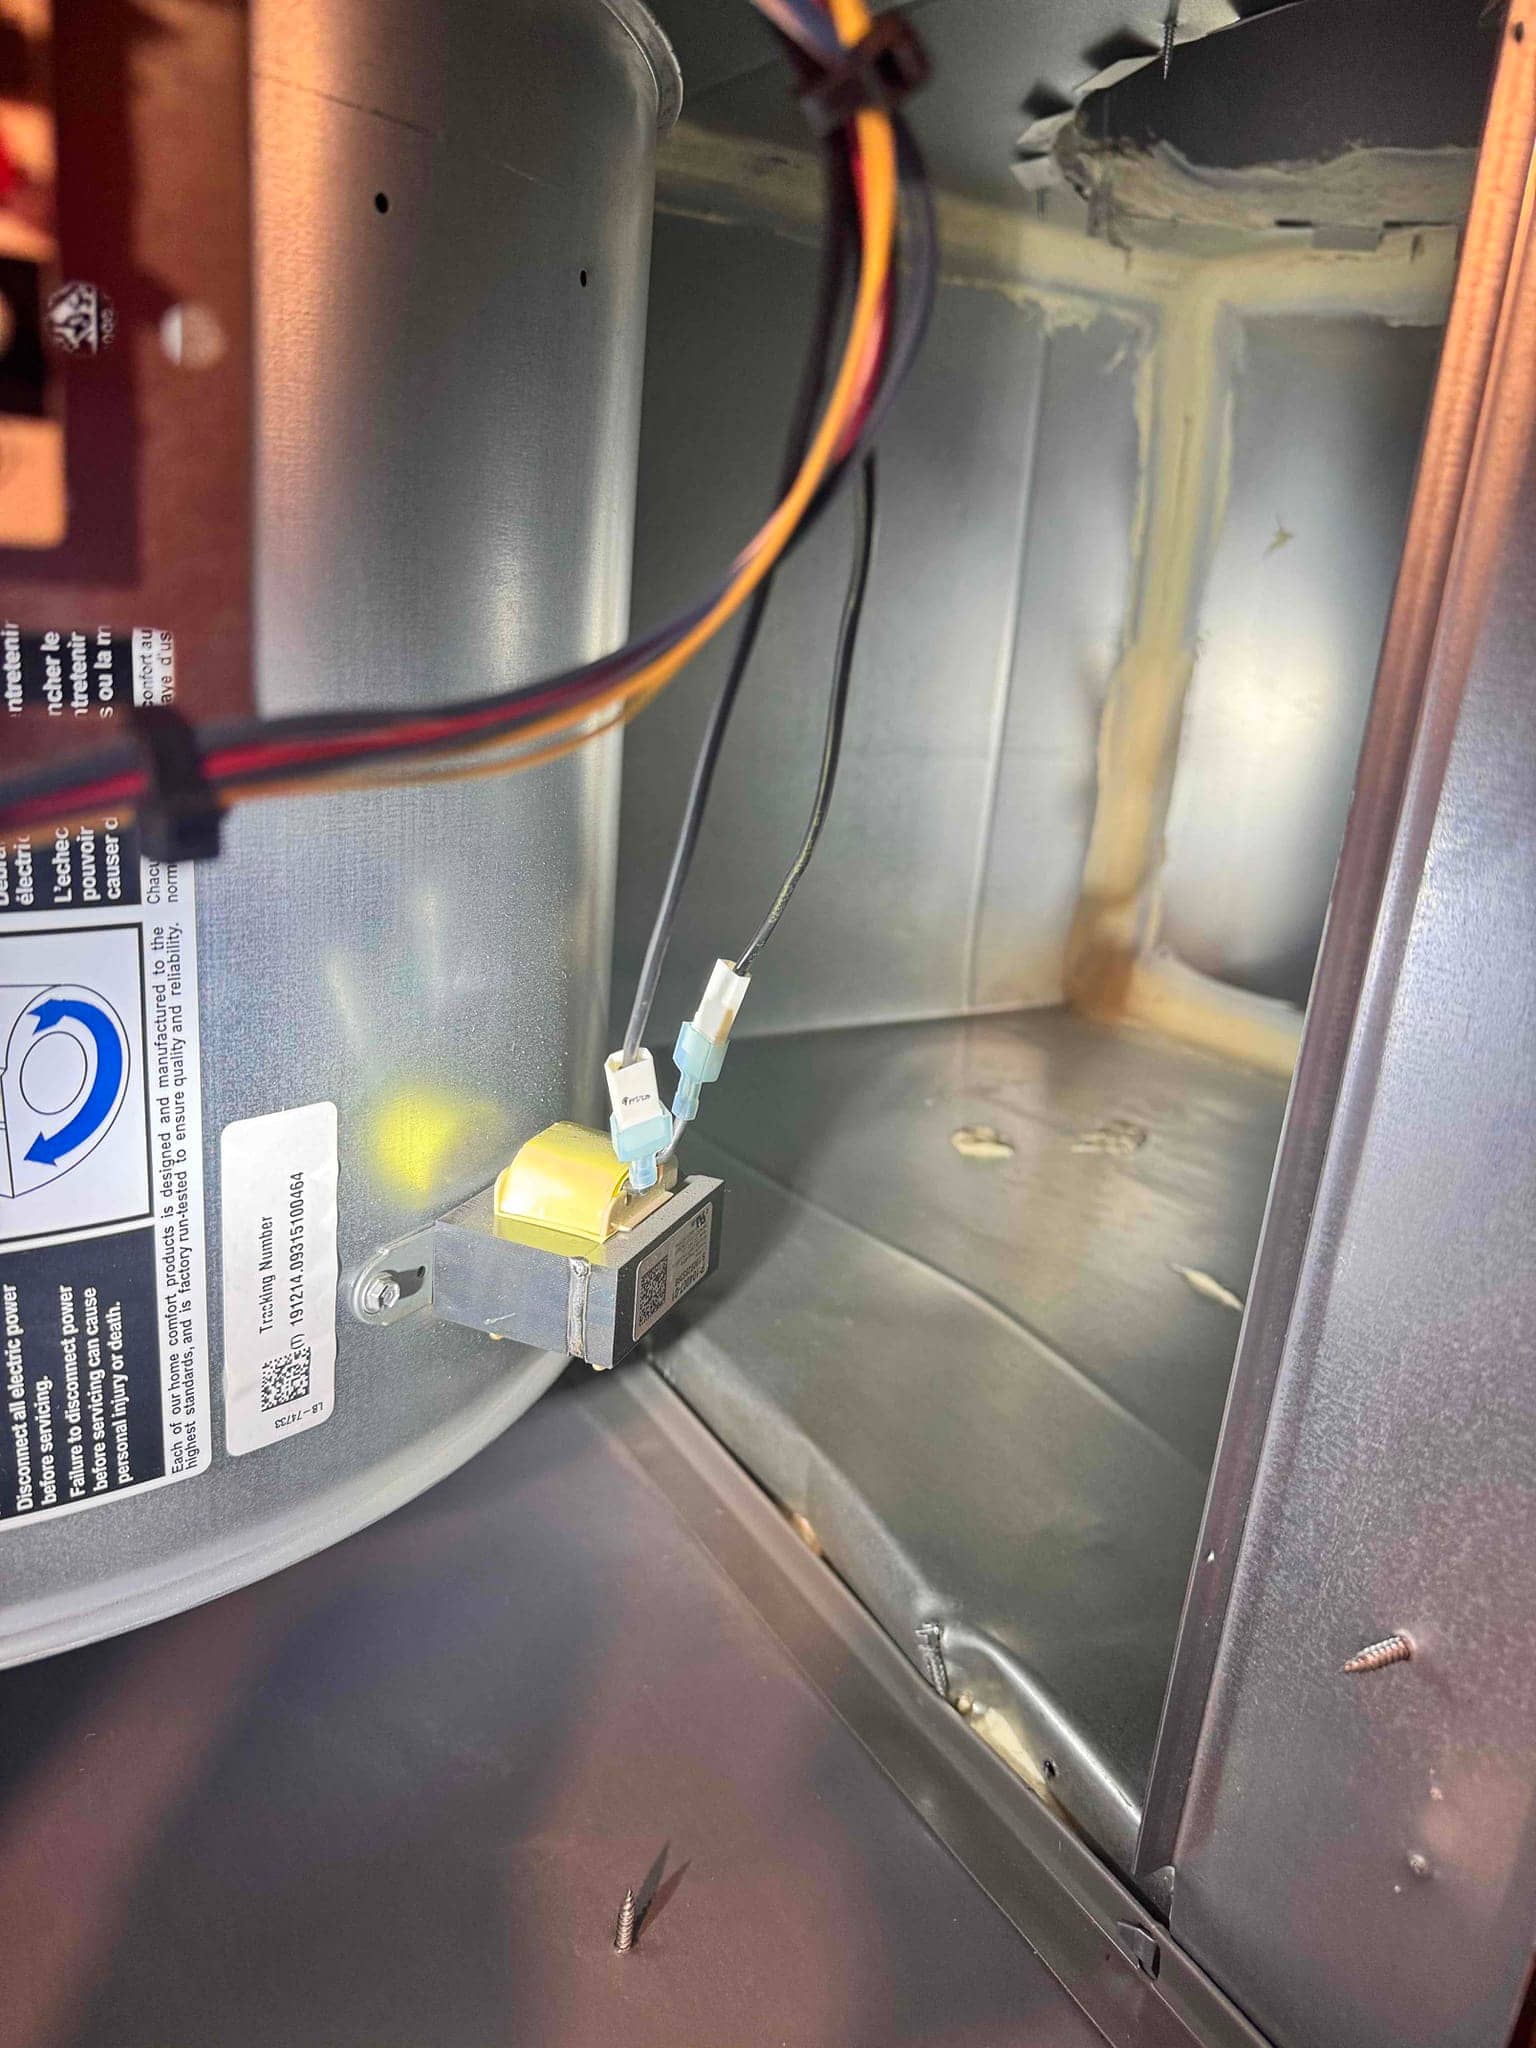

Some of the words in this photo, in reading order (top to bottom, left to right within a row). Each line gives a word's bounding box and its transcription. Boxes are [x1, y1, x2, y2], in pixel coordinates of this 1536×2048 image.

[40, 631, 60, 651] le
[93, 650, 112, 669] la
[96, 625, 111, 646] m
[42, 655, 62, 716] ncher
[98, 673, 113, 701] ou
[76, 826, 101, 901] pouvoir
[104, 834, 121, 900] causer
[146, 861, 161, 905] Chacu
[166, 863, 179, 903] norm
[150, 926, 165, 951] the
[167, 922, 183, 996] reliability.
[153, 959, 165, 975] to
[153, 984, 169, 1088] manufactured
[168, 1005, 182, 1033] and
[170, 1038, 188, 1087] quality
[156, 1097, 171, 1124] and
[173, 1091, 186, 1141] ensure
[159, 1132, 176, 1198] designed
[174, 1149, 187, 1163] to
[161, 1206, 173, 1219] is
[173, 1171, 190, 1242] run-tested
[161, 1226, 179, 1287] products
[259, 1216, 273, 1271] Number
[289, 1171, 305, 1326] 191214.09315100464
[178, 1247, 193, 1293] factory
[3, 1284, 24, 1337] power
[59, 1284, 79, 1336] power
[84, 1287, 99, 1336] cause
[105, 1301, 123, 1351] death.
[164, 1293, 179, 1346] comfort
[179, 1300, 191, 1313] is
[259, 1275, 275, 1334] Tracking
[86, 1337, 101, 1367] can
[179, 1319, 193, 1343] and
[5, 1338, 26, 1399] electric
[60, 1337, 81, 1424] disconnect
[110, 1353, 124, 1370] or
[168, 1353, 180, 1390] home
[181, 1346, 196, 1415] standards,
[8, 1400, 26, 1421] all
[33, 1375, 53, 1453] servicing.
[87, 1369, 105, 1440] servicing
[110, 1374, 130, 1418] injury
[170, 1393, 182, 1415] our
[67, 1426, 82, 1443] to
[112, 1419, 134, 1484] personal
[169, 1421, 182, 1435] of
[185, 1420, 200, 1470] highest
[12, 1422, 33, 1512] Disconnect
[38, 1454, 57, 1505] before
[68, 1445, 86, 1497] Failure
[92, 1442, 109, 1492] before
[171, 1441, 185, 1474] Each
